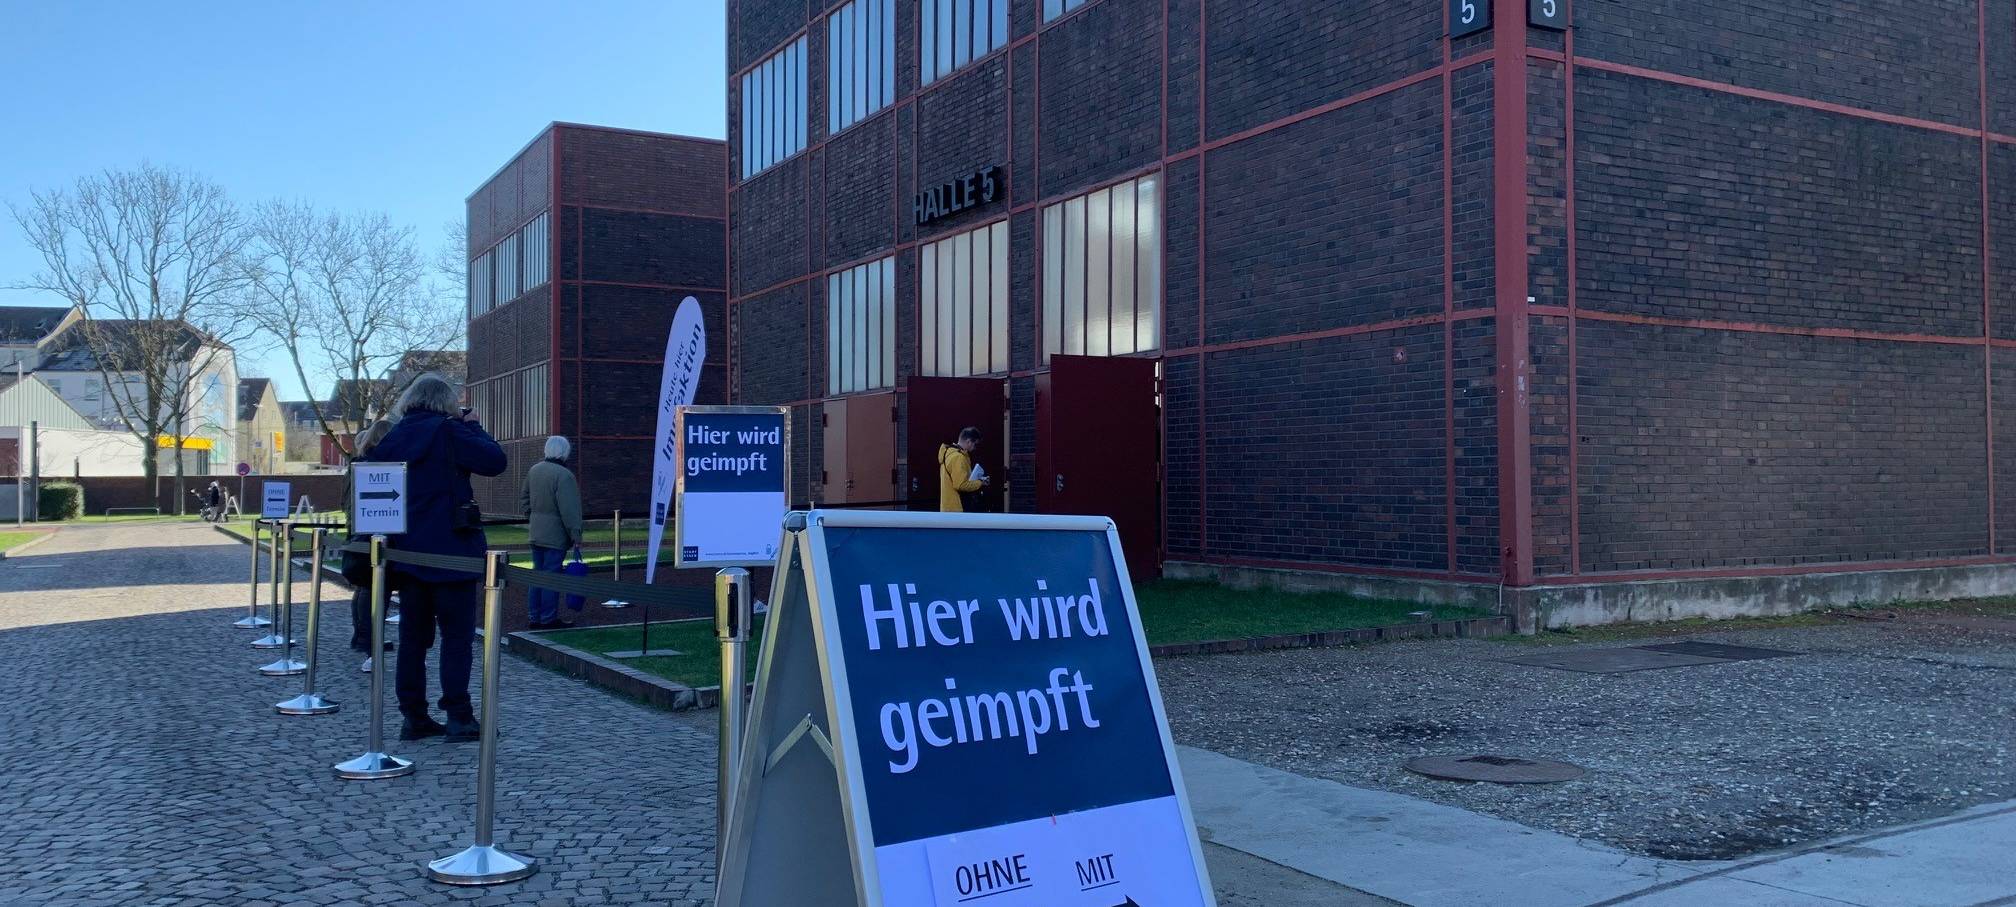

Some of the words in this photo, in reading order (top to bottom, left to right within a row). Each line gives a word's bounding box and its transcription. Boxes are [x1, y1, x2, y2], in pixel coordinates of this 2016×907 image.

[912, 174, 976, 225] HALLE
[980, 165, 995, 202] 5
[688, 425, 731, 445] Hier
[737, 426, 780, 445] wird
[368, 472, 391, 483] MIT
[687, 452, 768, 476] geimpft
[360, 506, 400, 518] Termin
[859, 583, 980, 650] Hier
[997, 578, 1109, 641] wird
[879, 667, 1100, 774] geimpft
[955, 854, 1031, 896] OHNE
[1075, 854, 1115, 887] MIT
